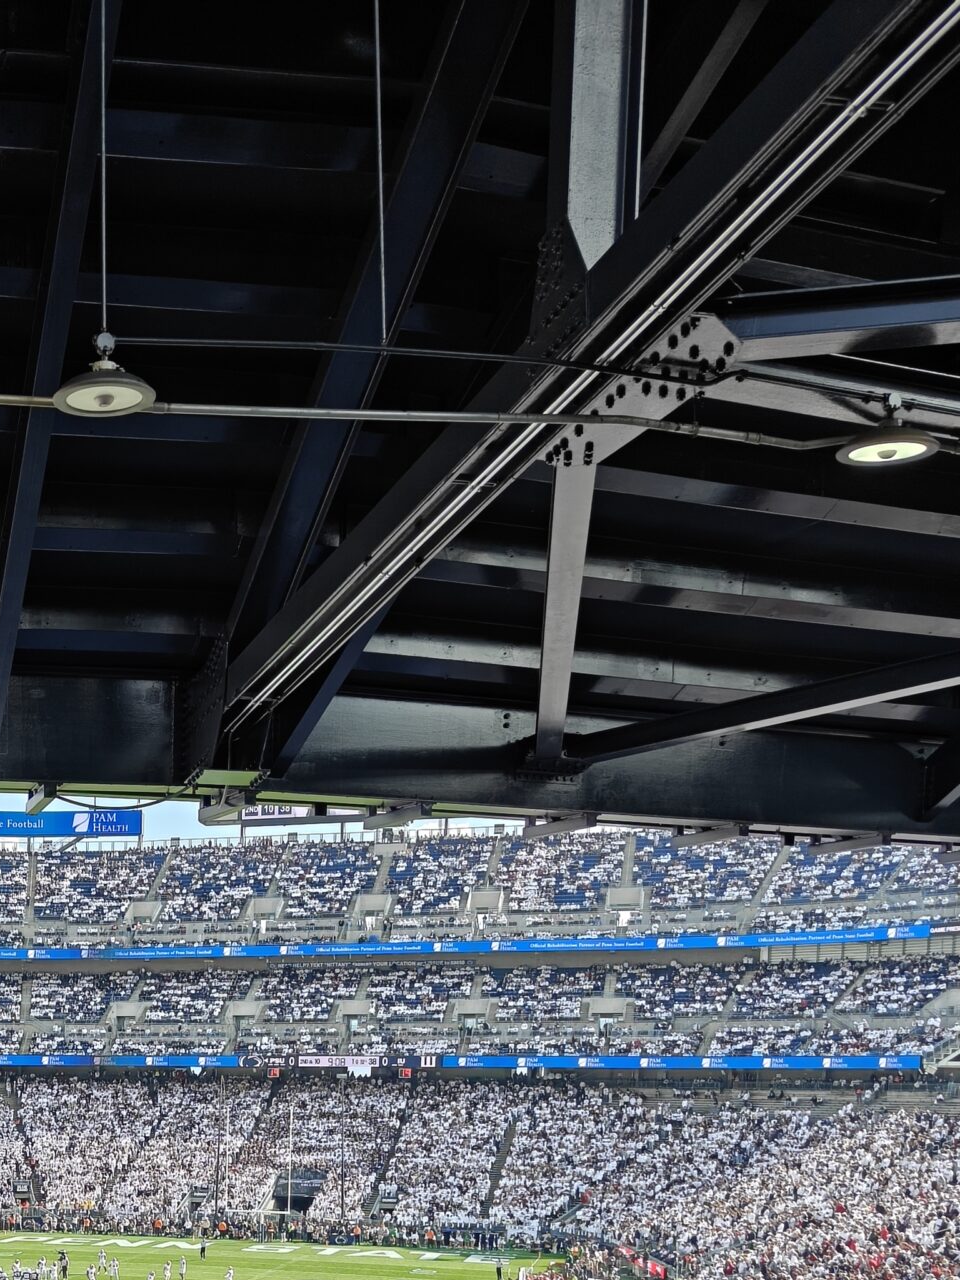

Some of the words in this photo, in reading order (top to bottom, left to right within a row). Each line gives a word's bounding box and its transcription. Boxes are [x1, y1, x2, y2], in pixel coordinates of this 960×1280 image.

[264, 805, 274, 813] 10
[93, 813, 117, 822] PAM
[7, 817, 44, 828] Football
[289, 1057, 295, 1065] 0
[241, 1244, 518, 1265] STATE
